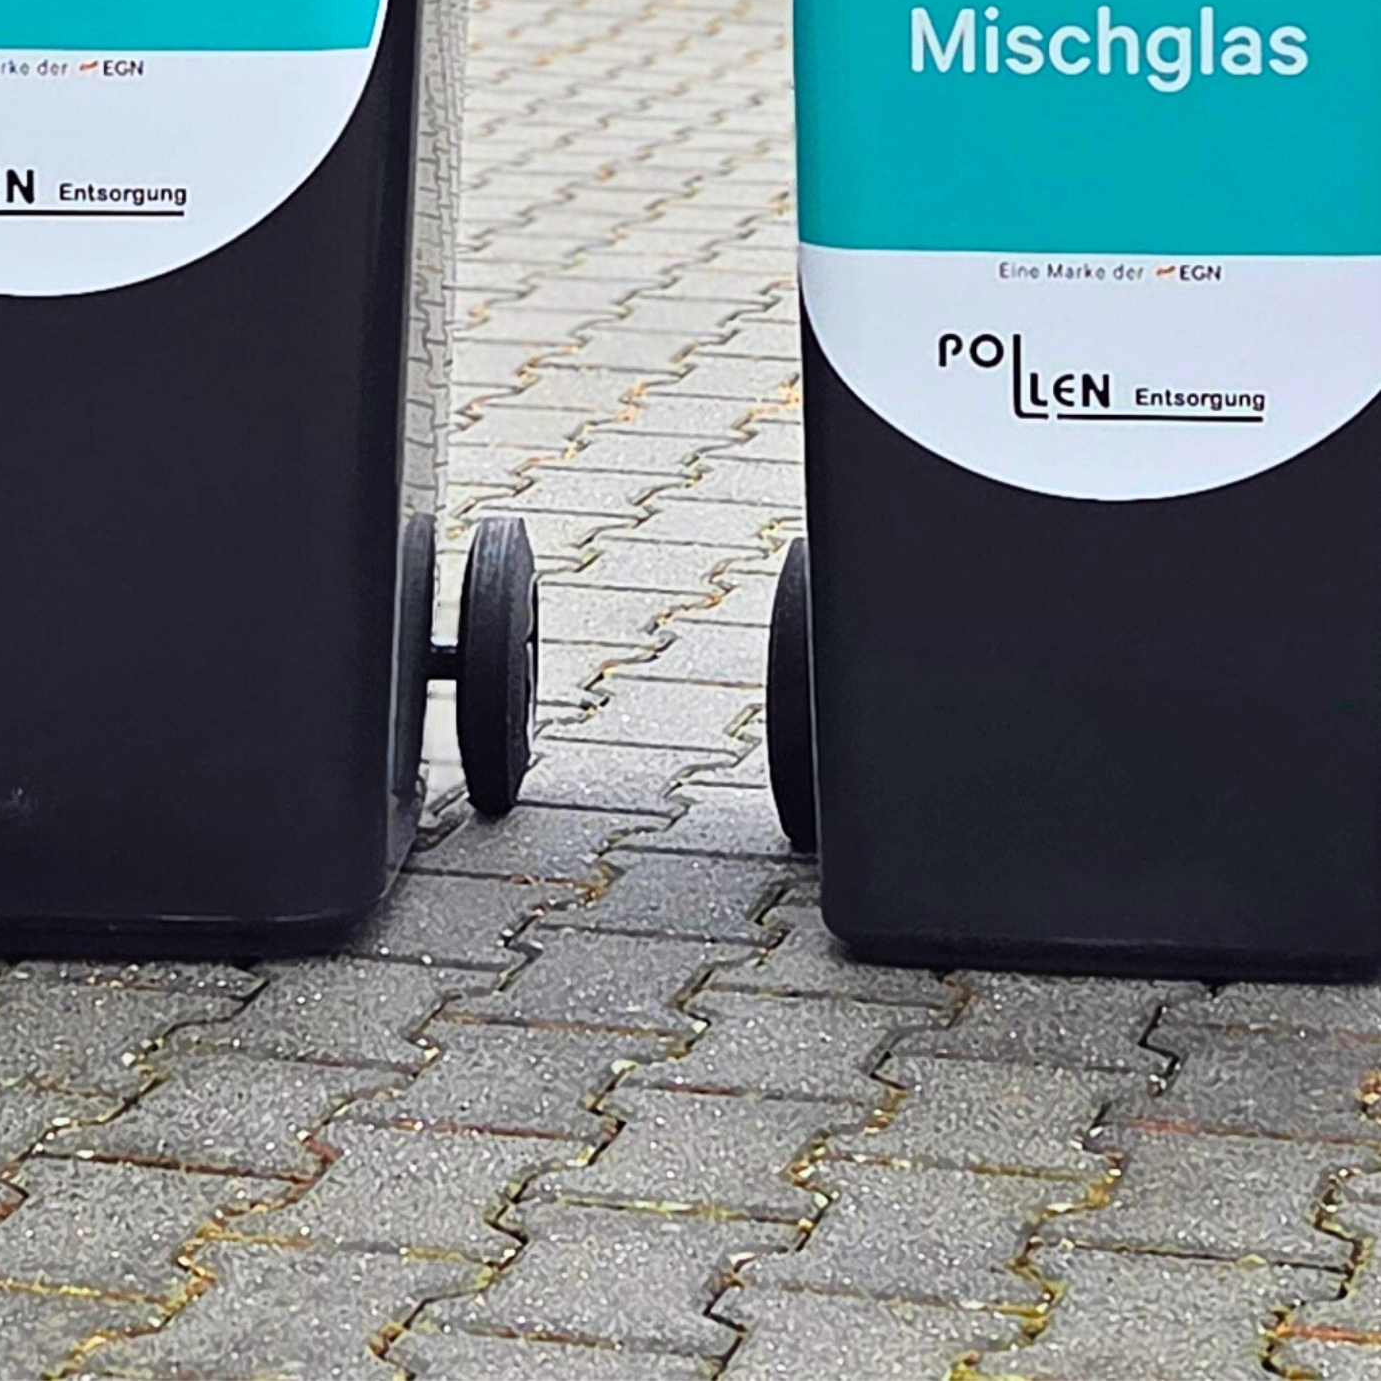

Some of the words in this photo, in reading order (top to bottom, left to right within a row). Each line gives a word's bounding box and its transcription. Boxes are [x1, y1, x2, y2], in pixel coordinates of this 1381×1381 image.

[910, 5, 1309, 93] Mischglas
[36, 59, 68, 76] der
[103, 60, 144, 76] EGN
[58, 182, 188, 207] Entsorgung
[999, 261, 1040, 278] Eine
[1047, 263, 1106, 280] Marke
[1112, 264, 1144, 280] der
[1179, 265, 1222, 281] EGN
[938, 332, 1111, 421] POLLEN
[1134, 387, 1266, 412] Entsorgung
